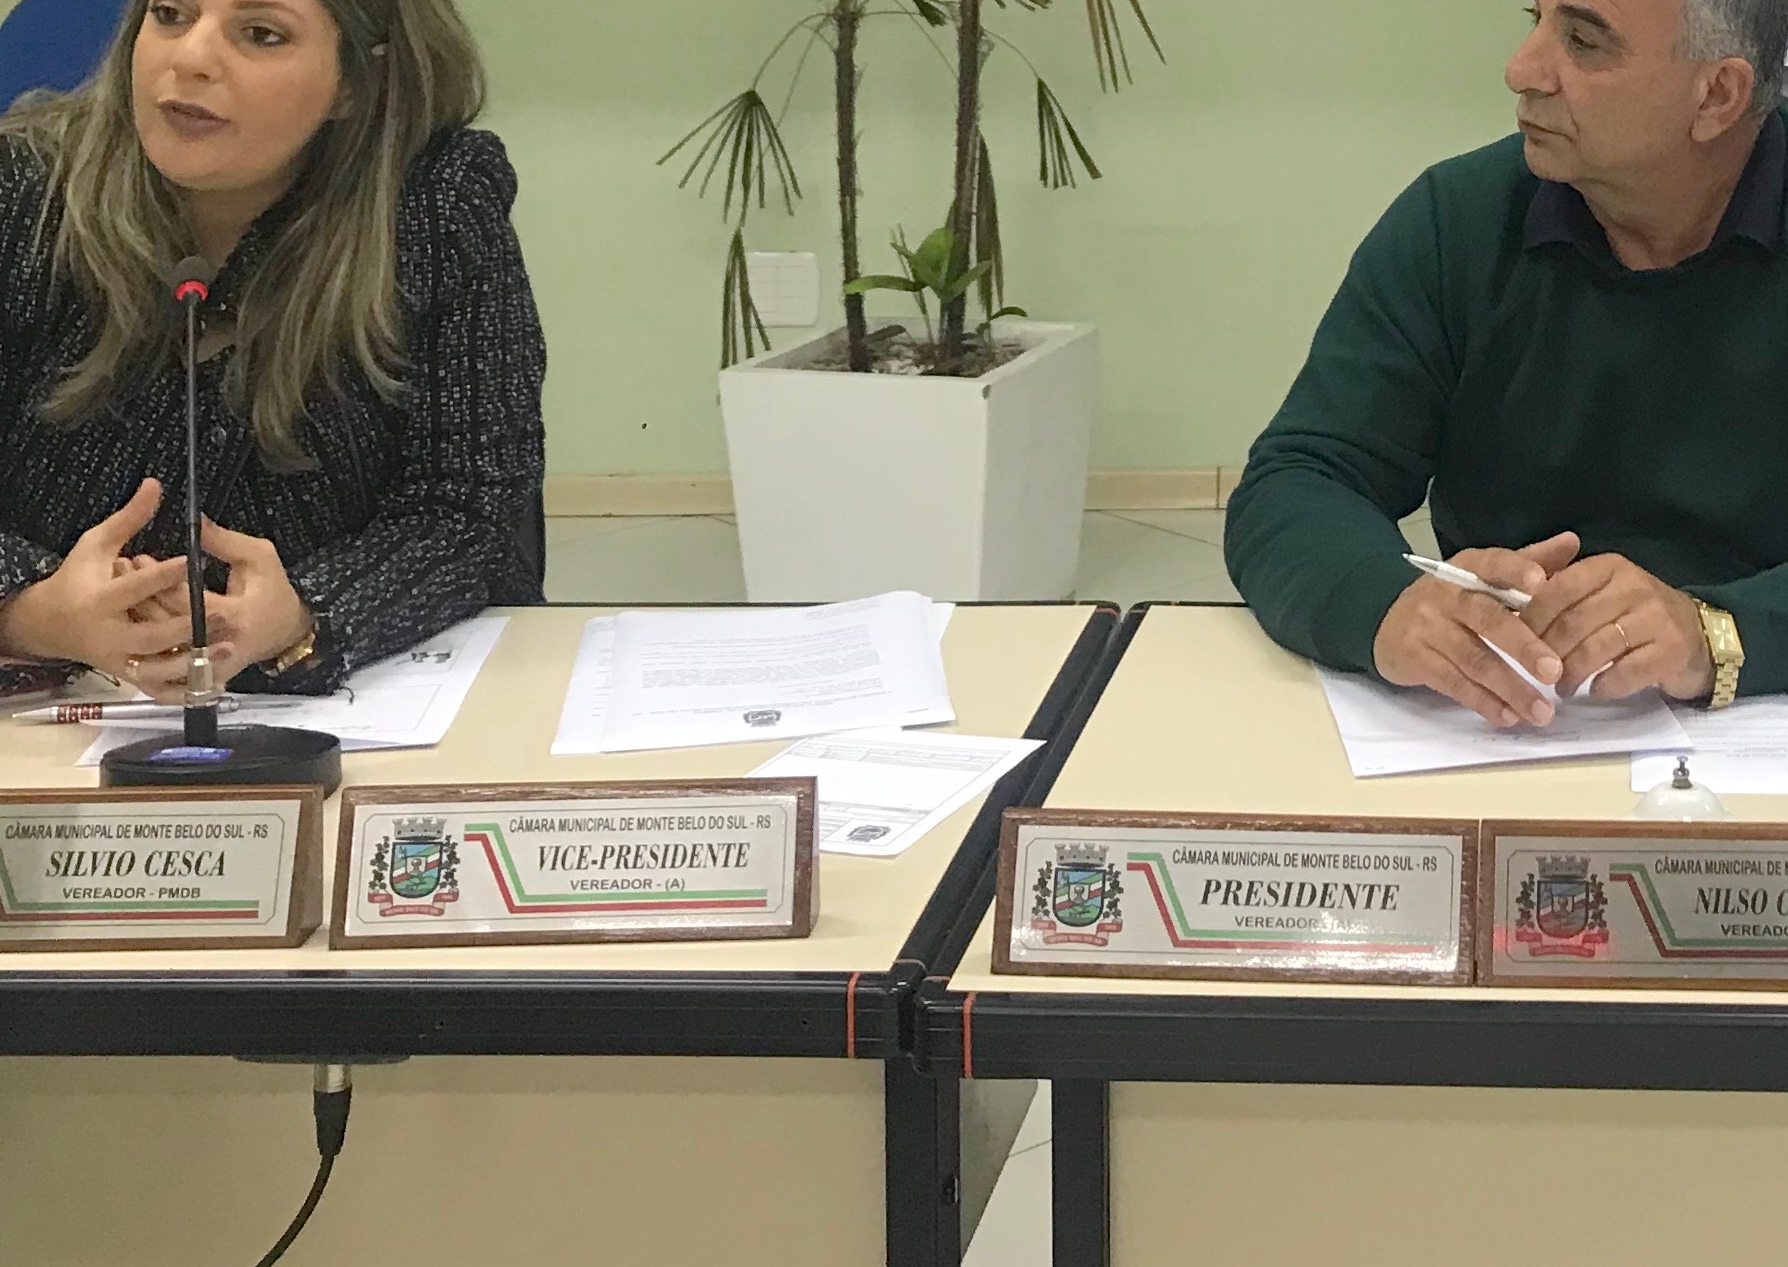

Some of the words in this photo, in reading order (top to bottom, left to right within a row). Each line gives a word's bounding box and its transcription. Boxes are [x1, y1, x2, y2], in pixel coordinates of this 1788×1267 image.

[5, 821, 53, 839] CÂMARA
[55, 824, 114, 839] MUNICIPAL
[117, 824, 131, 839] DE
[133, 824, 173, 839] MONTE
[175, 824, 203, 839] BELO
[206, 824, 222, 839] DO
[224, 824, 244, 839] SUL
[253, 824, 269, 839] RS
[509, 816, 555, 833] CÂMARA
[557, 817, 616, 832] MUNICIPAL
[619, 817, 634, 831] DE
[636, 816, 675, 831] MONTE
[677, 815, 706, 830] BELO
[708, 815, 724, 829] DO
[726, 815, 748, 829] SUL
[756, 814, 771, 829] RS
[45, 849, 136, 877] SILVIO
[144, 850, 226, 877] CESCA
[538, 842, 751, 871] VICE-PRESIDENTE
[1172, 847, 1219, 865] CÂMARA
[1221, 851, 1281, 867] MUNICIPAL
[1284, 853, 1299, 868] DE
[1301, 853, 1340, 869] MONTE
[1342, 854, 1370, 870] BELO
[1374, 855, 1390, 870] DO
[1392, 855, 1414, 871] SUL
[1422, 856, 1438, 872] RS
[1655, 856, 1701, 875] CÂMARA
[1704, 860, 1765, 876] MUNICIPAL
[1768, 861, 1782, 876] DE
[62, 887, 147, 900] VEREADOR
[158, 887, 201, 899] PMDB
[570, 878, 653, 891] VEREADOR
[665, 877, 686, 893] (A)
[1199, 878, 1400, 911] PRESIDENTE
[1694, 887, 1768, 915] NILSO
[1234, 915, 1318, 929] VEREADOR
